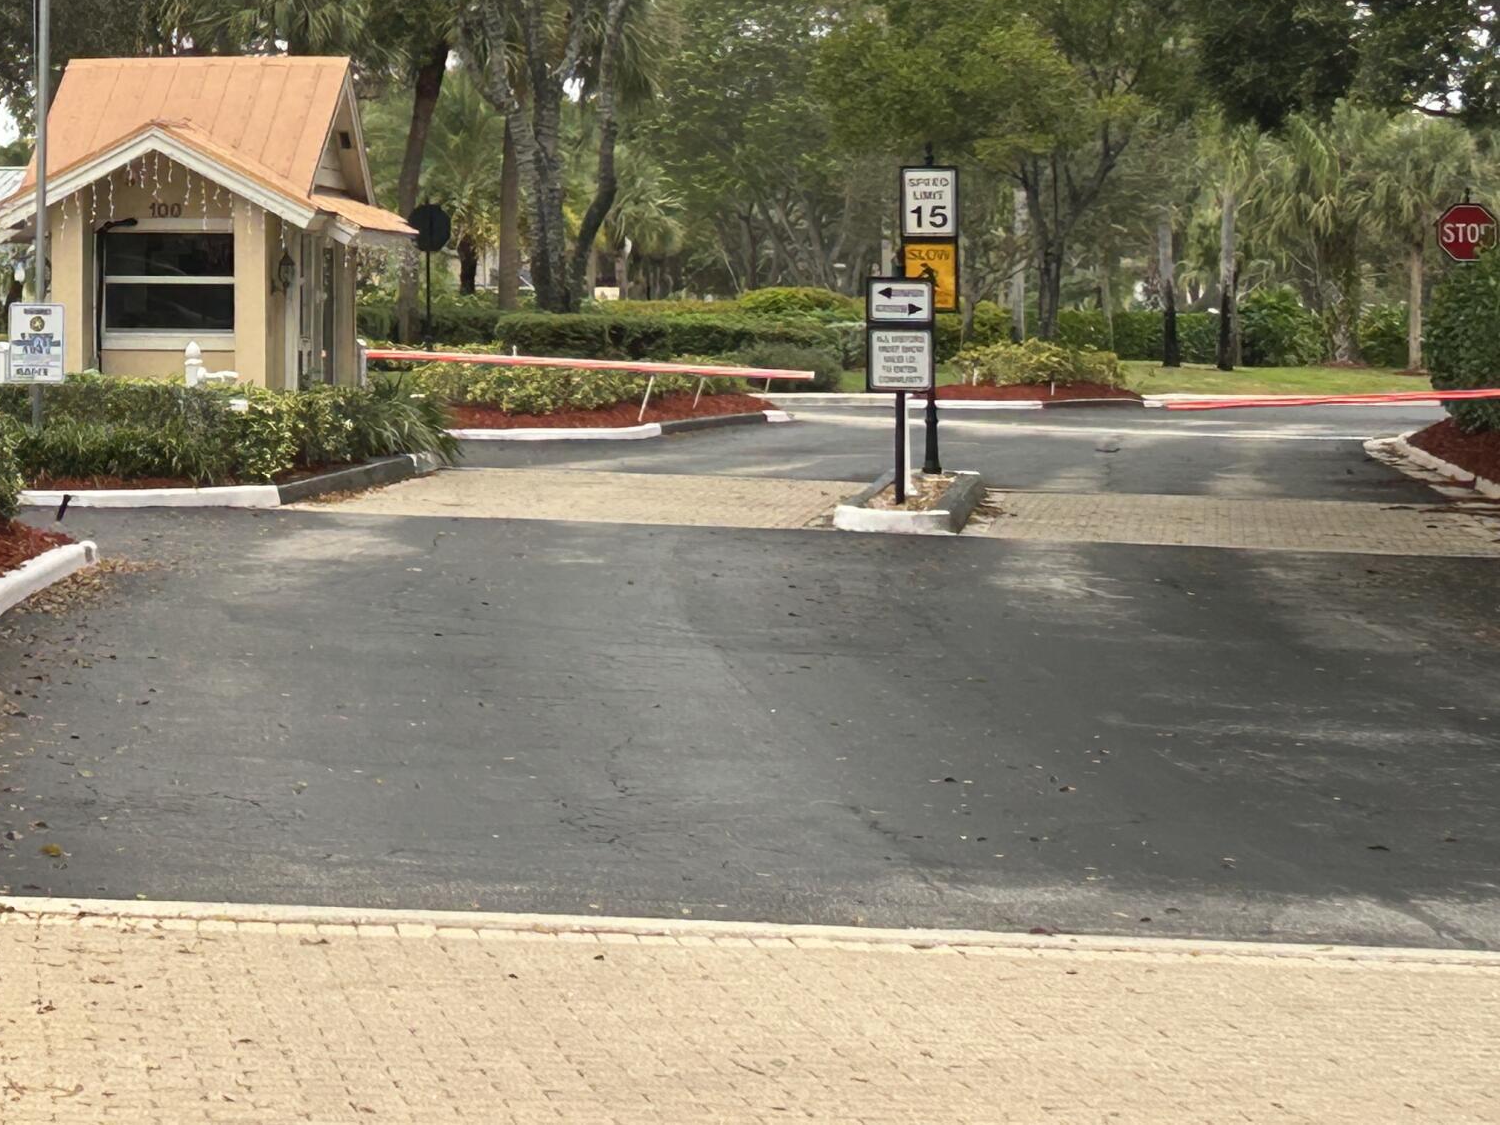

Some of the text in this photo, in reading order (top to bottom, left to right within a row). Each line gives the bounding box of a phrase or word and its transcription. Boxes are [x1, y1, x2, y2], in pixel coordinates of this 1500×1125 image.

[908, 177, 949, 187] SPEED
[913, 190, 944, 200] LIMIT
[149, 202, 182, 218] 100
[910, 205, 948, 228] 15
[907, 249, 950, 261] SLOW
